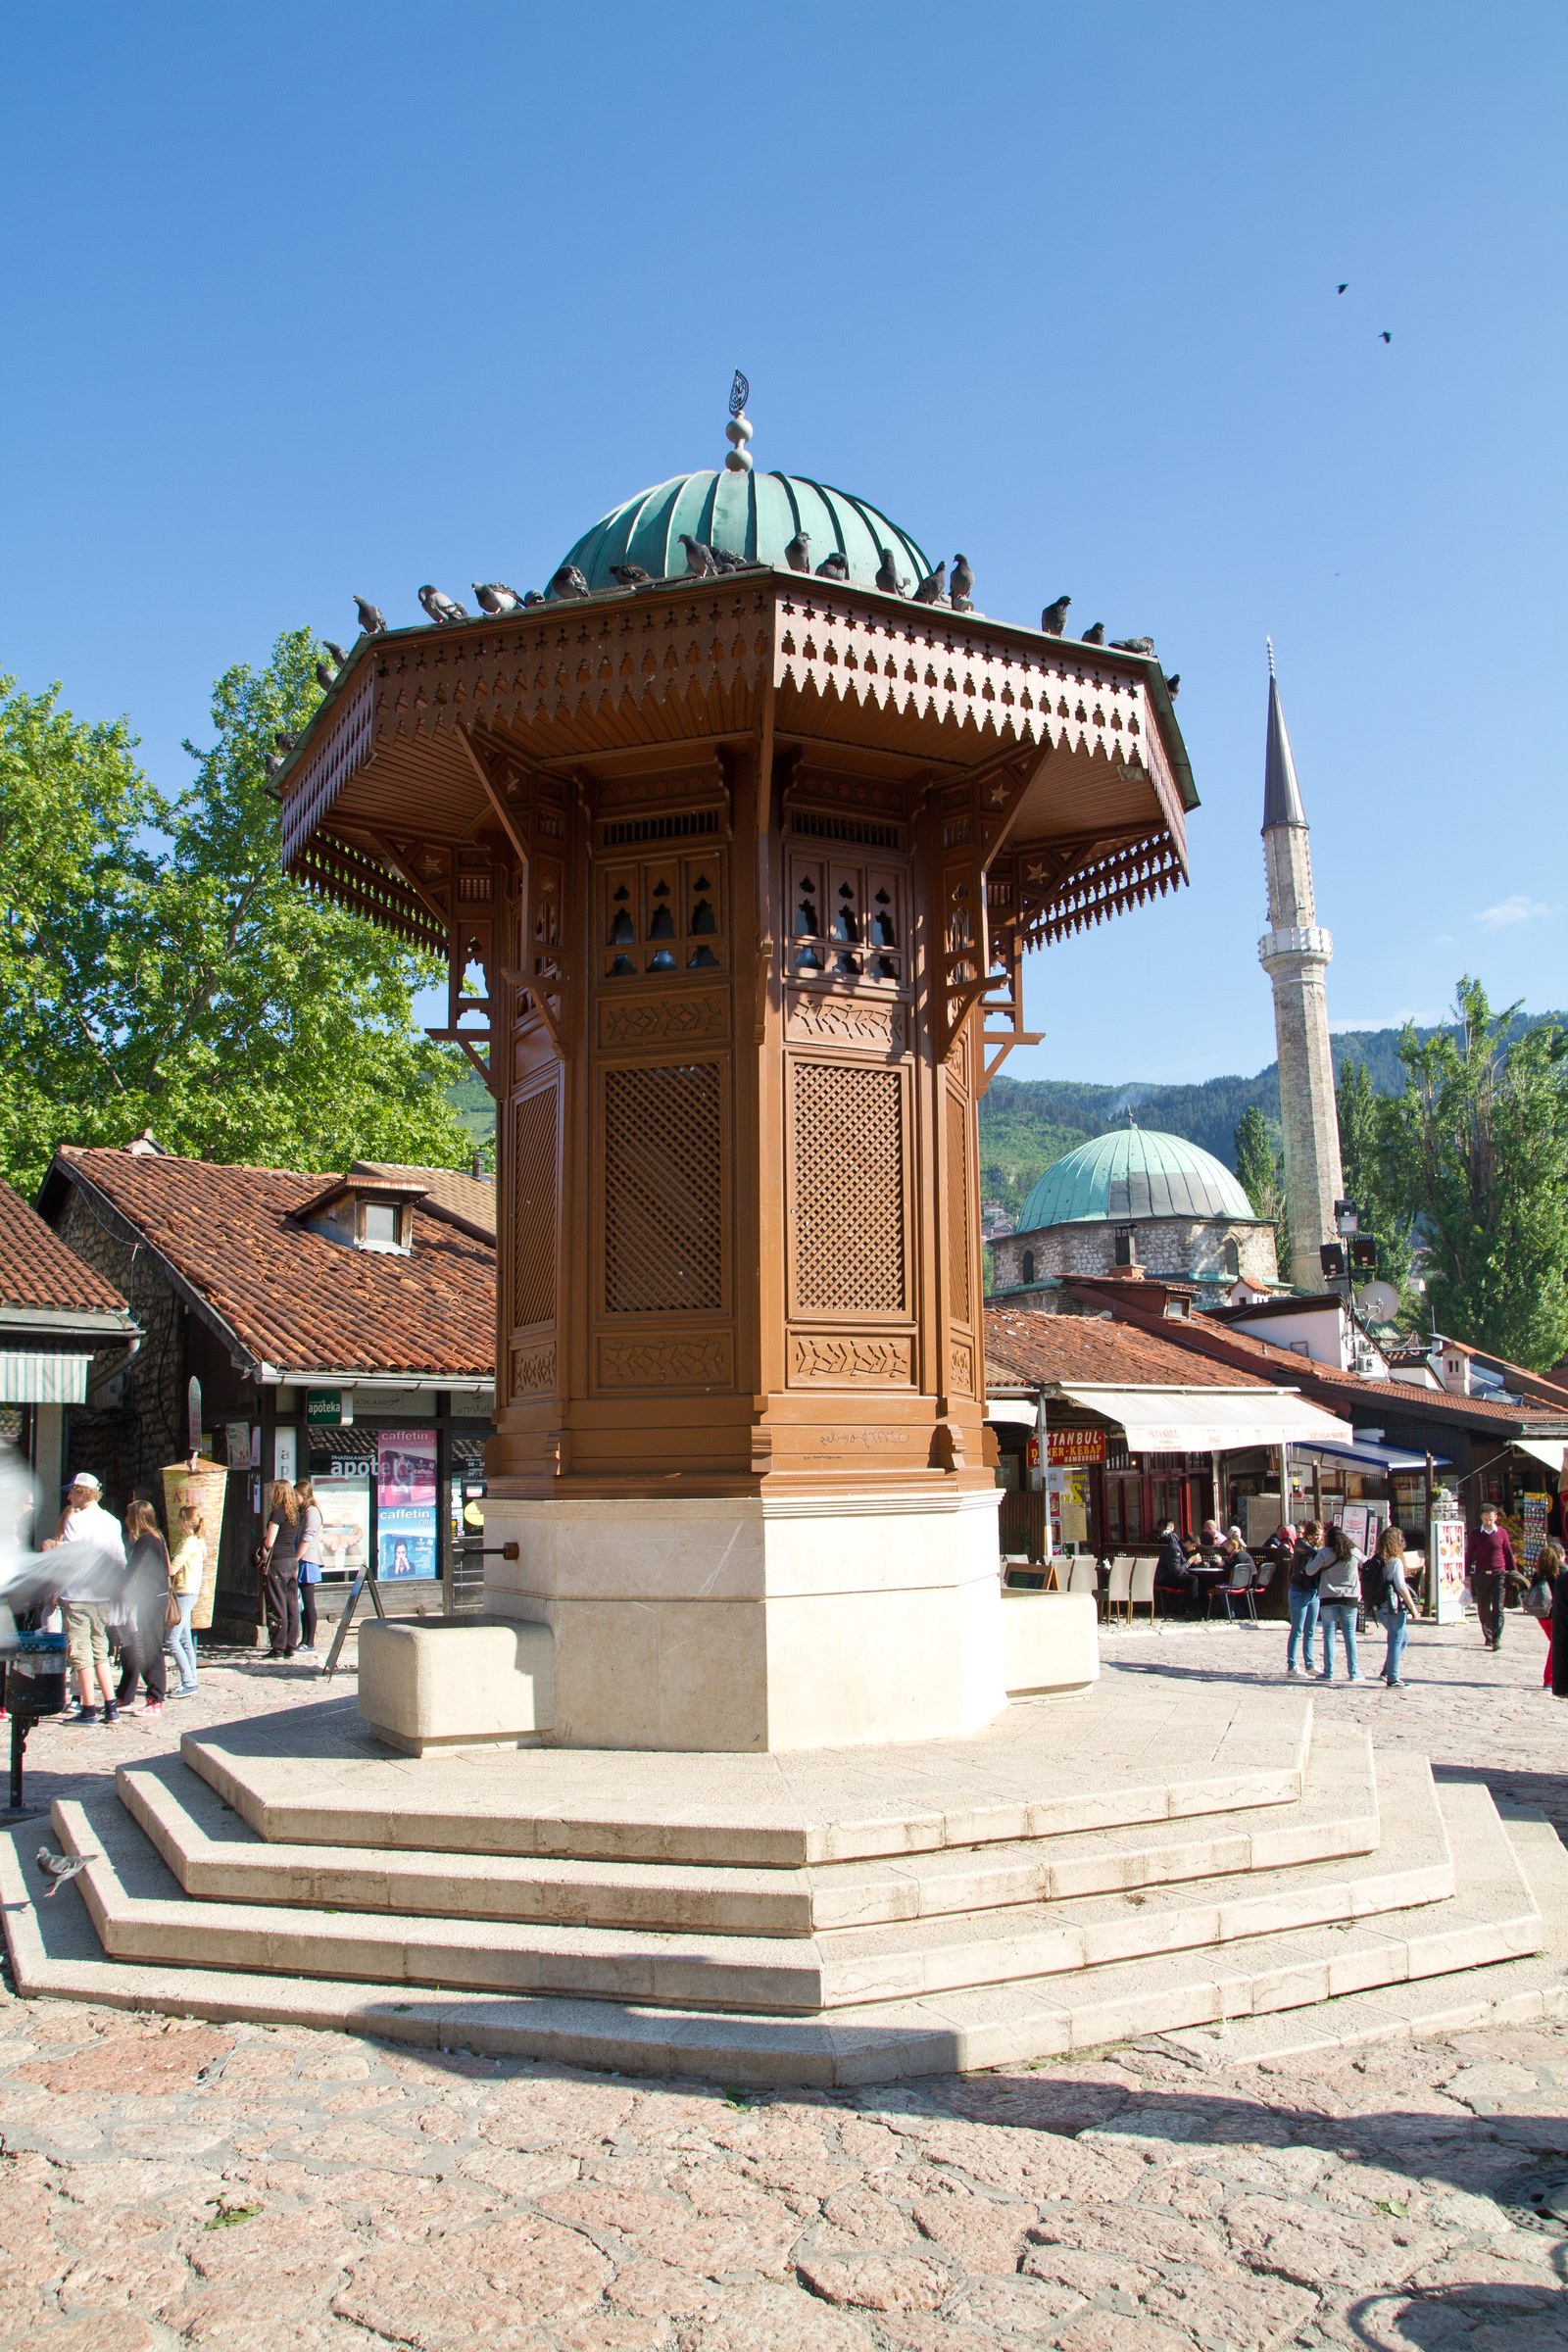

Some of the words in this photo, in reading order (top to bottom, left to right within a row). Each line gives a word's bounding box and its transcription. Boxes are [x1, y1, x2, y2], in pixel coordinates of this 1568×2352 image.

[308, 1401, 341, 1415] apoteka
[381, 1431, 428, 1441] caffetin
[1046, 1431, 1099, 1446] STANBUL
[1031, 1446, 1064, 1458] DNER
[1070, 1445, 1102, 1456] KEBAP
[1063, 1454, 1100, 1463] HAMBURGER
[379, 1509, 430, 1520] caffetin
